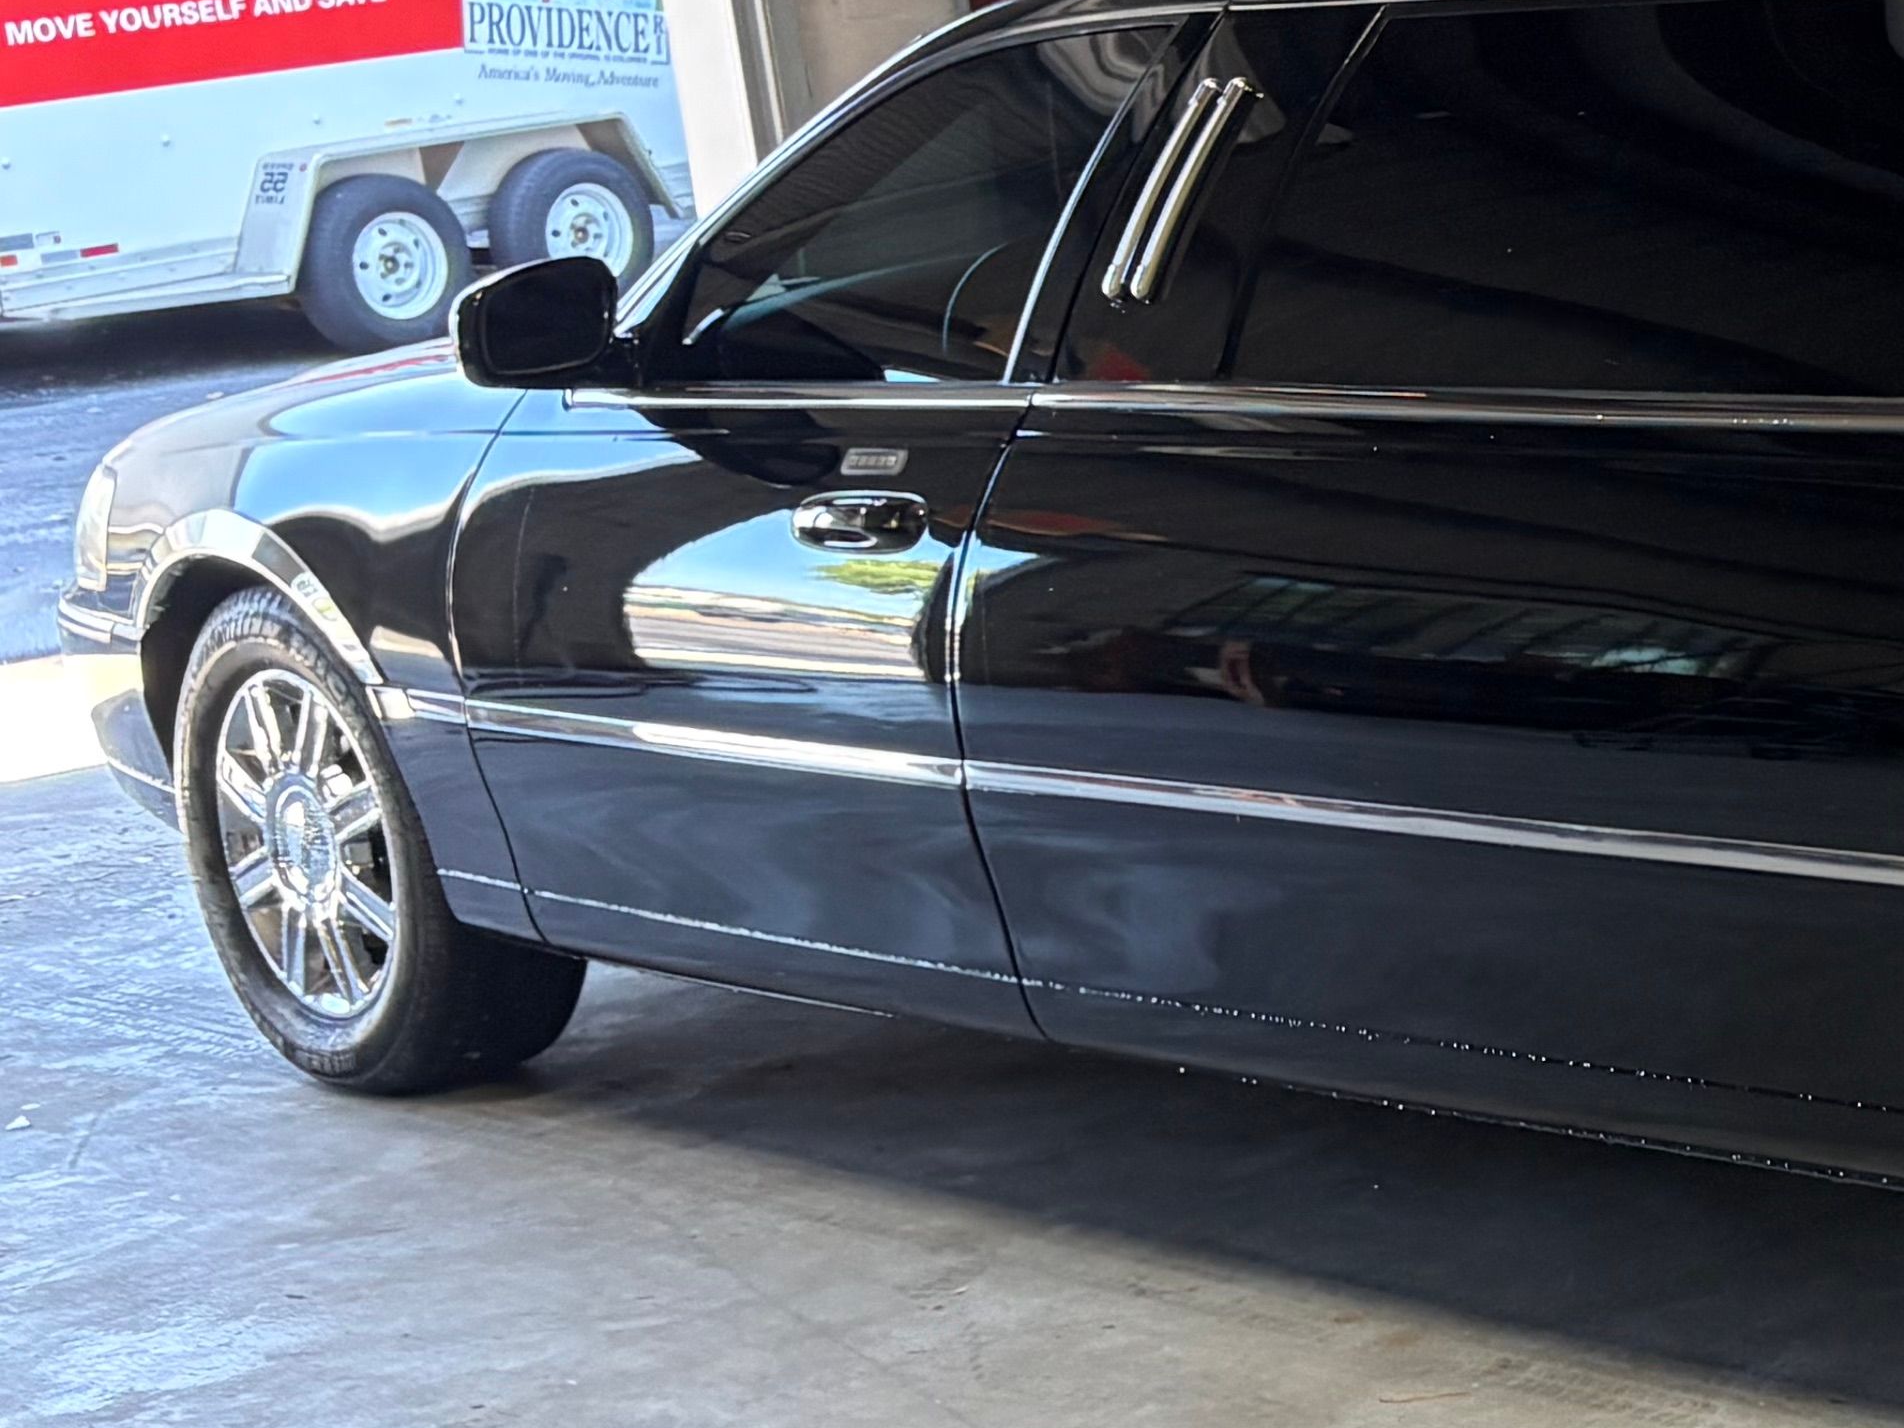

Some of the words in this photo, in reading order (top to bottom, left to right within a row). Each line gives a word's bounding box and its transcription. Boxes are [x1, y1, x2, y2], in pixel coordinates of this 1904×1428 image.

[5, 12, 96, 46] MOVE
[467, 1, 651, 54] PROVIDENCE
[477, 63, 540, 82] America's
